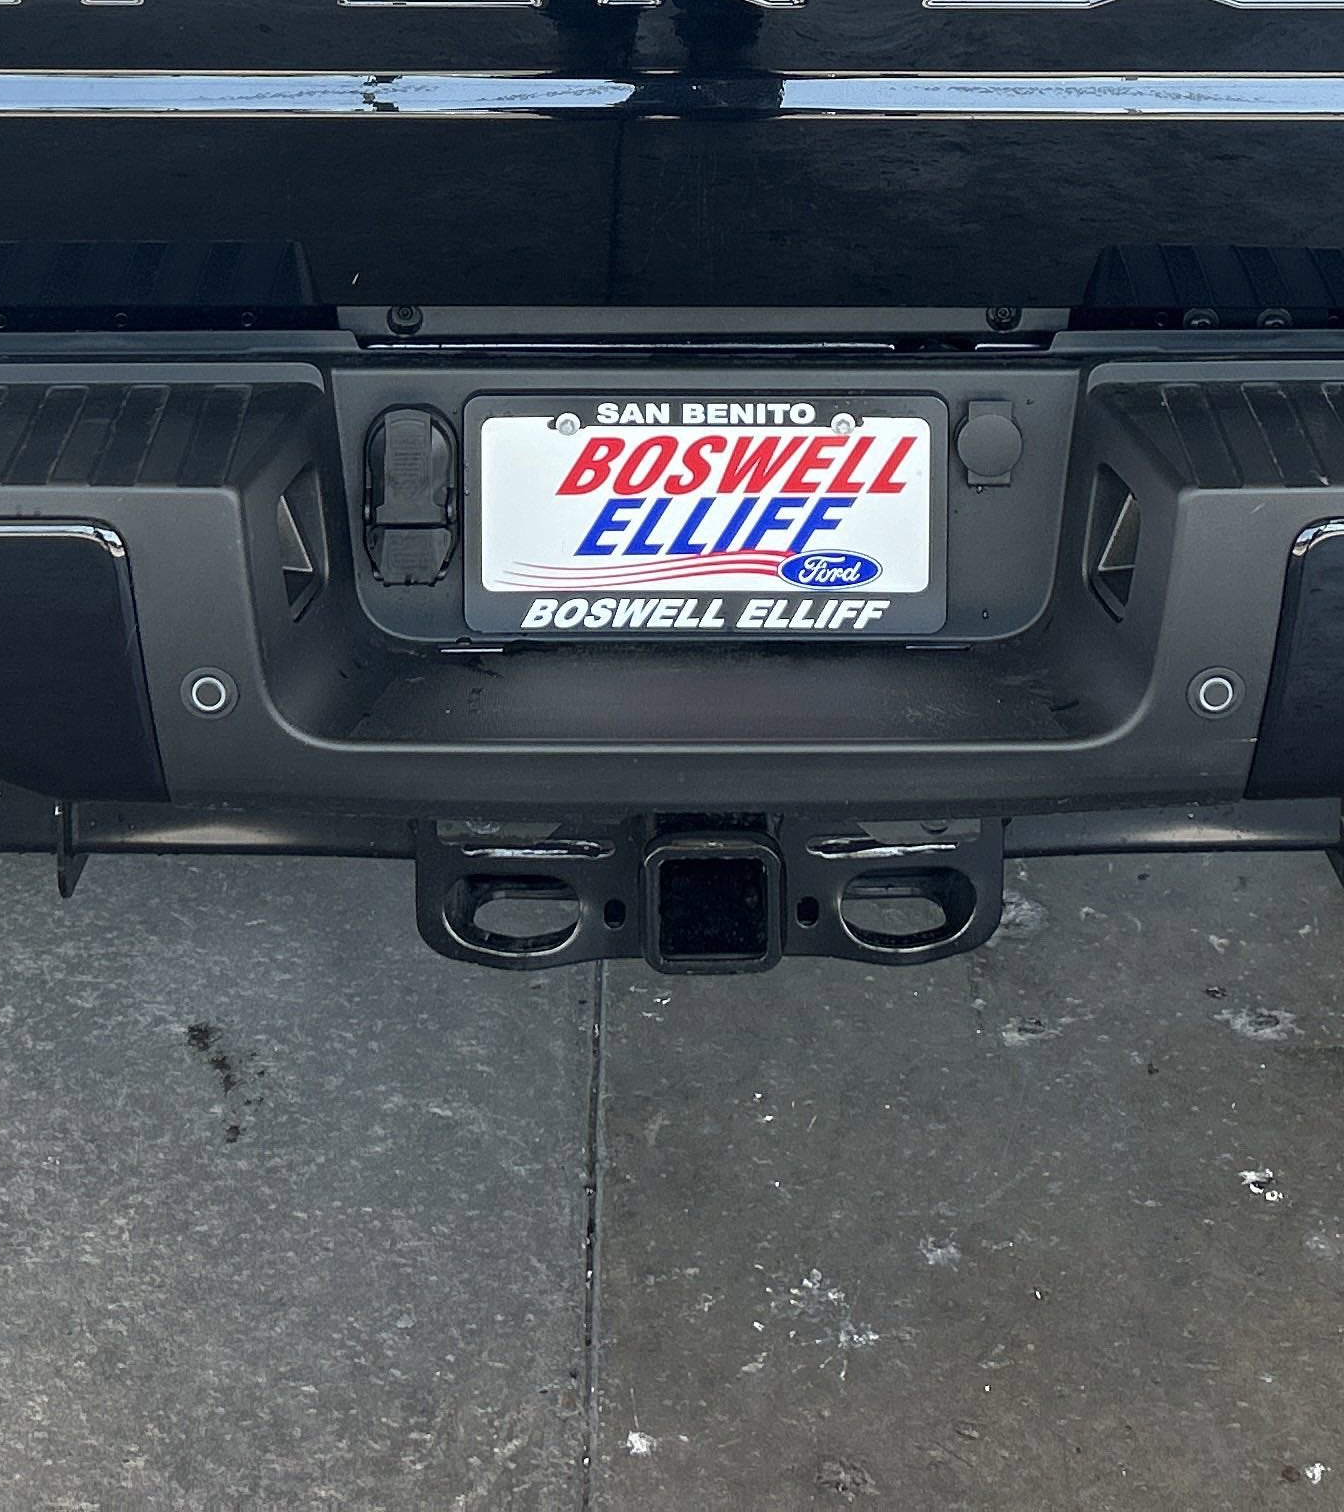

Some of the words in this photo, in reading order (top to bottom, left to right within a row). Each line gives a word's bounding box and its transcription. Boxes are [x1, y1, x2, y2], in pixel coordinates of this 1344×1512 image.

[596, 402, 670, 425] SAN
[682, 402, 816, 425] BENITO
[555, 435, 918, 496] BOSWELL
[574, 496, 858, 556] ELLIFF
[798, 555, 861, 584] Ford
[520, 597, 727, 629] BOSWELL
[735, 598, 891, 631] ELLIFF
